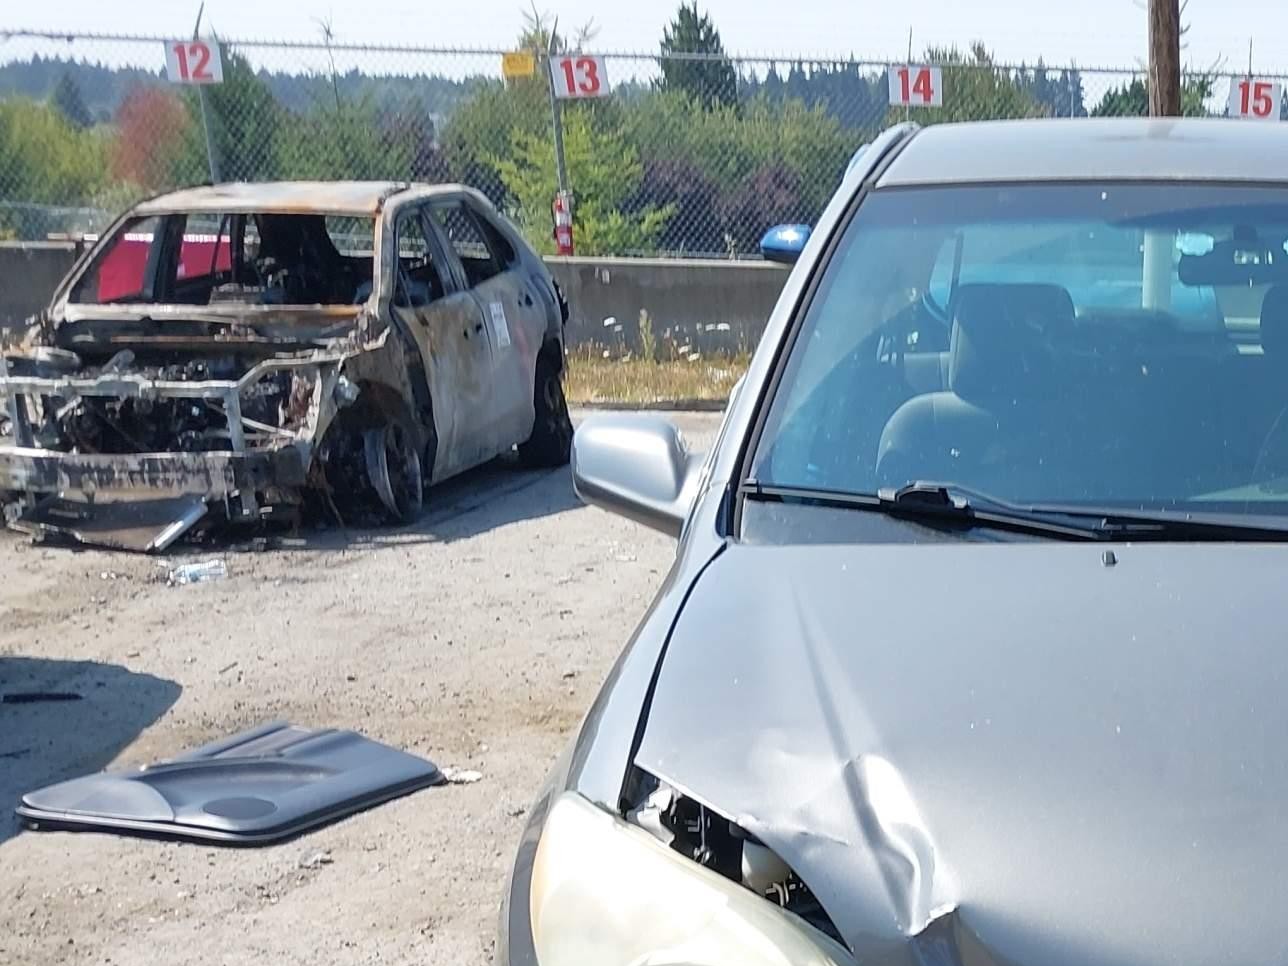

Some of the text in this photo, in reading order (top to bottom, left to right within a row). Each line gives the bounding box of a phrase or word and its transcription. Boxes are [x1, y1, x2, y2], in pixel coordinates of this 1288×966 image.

[174, 43, 213, 79] 12
[560, 57, 600, 94] 13
[897, 67, 935, 102] 14
[1239, 81, 1273, 117] 15
